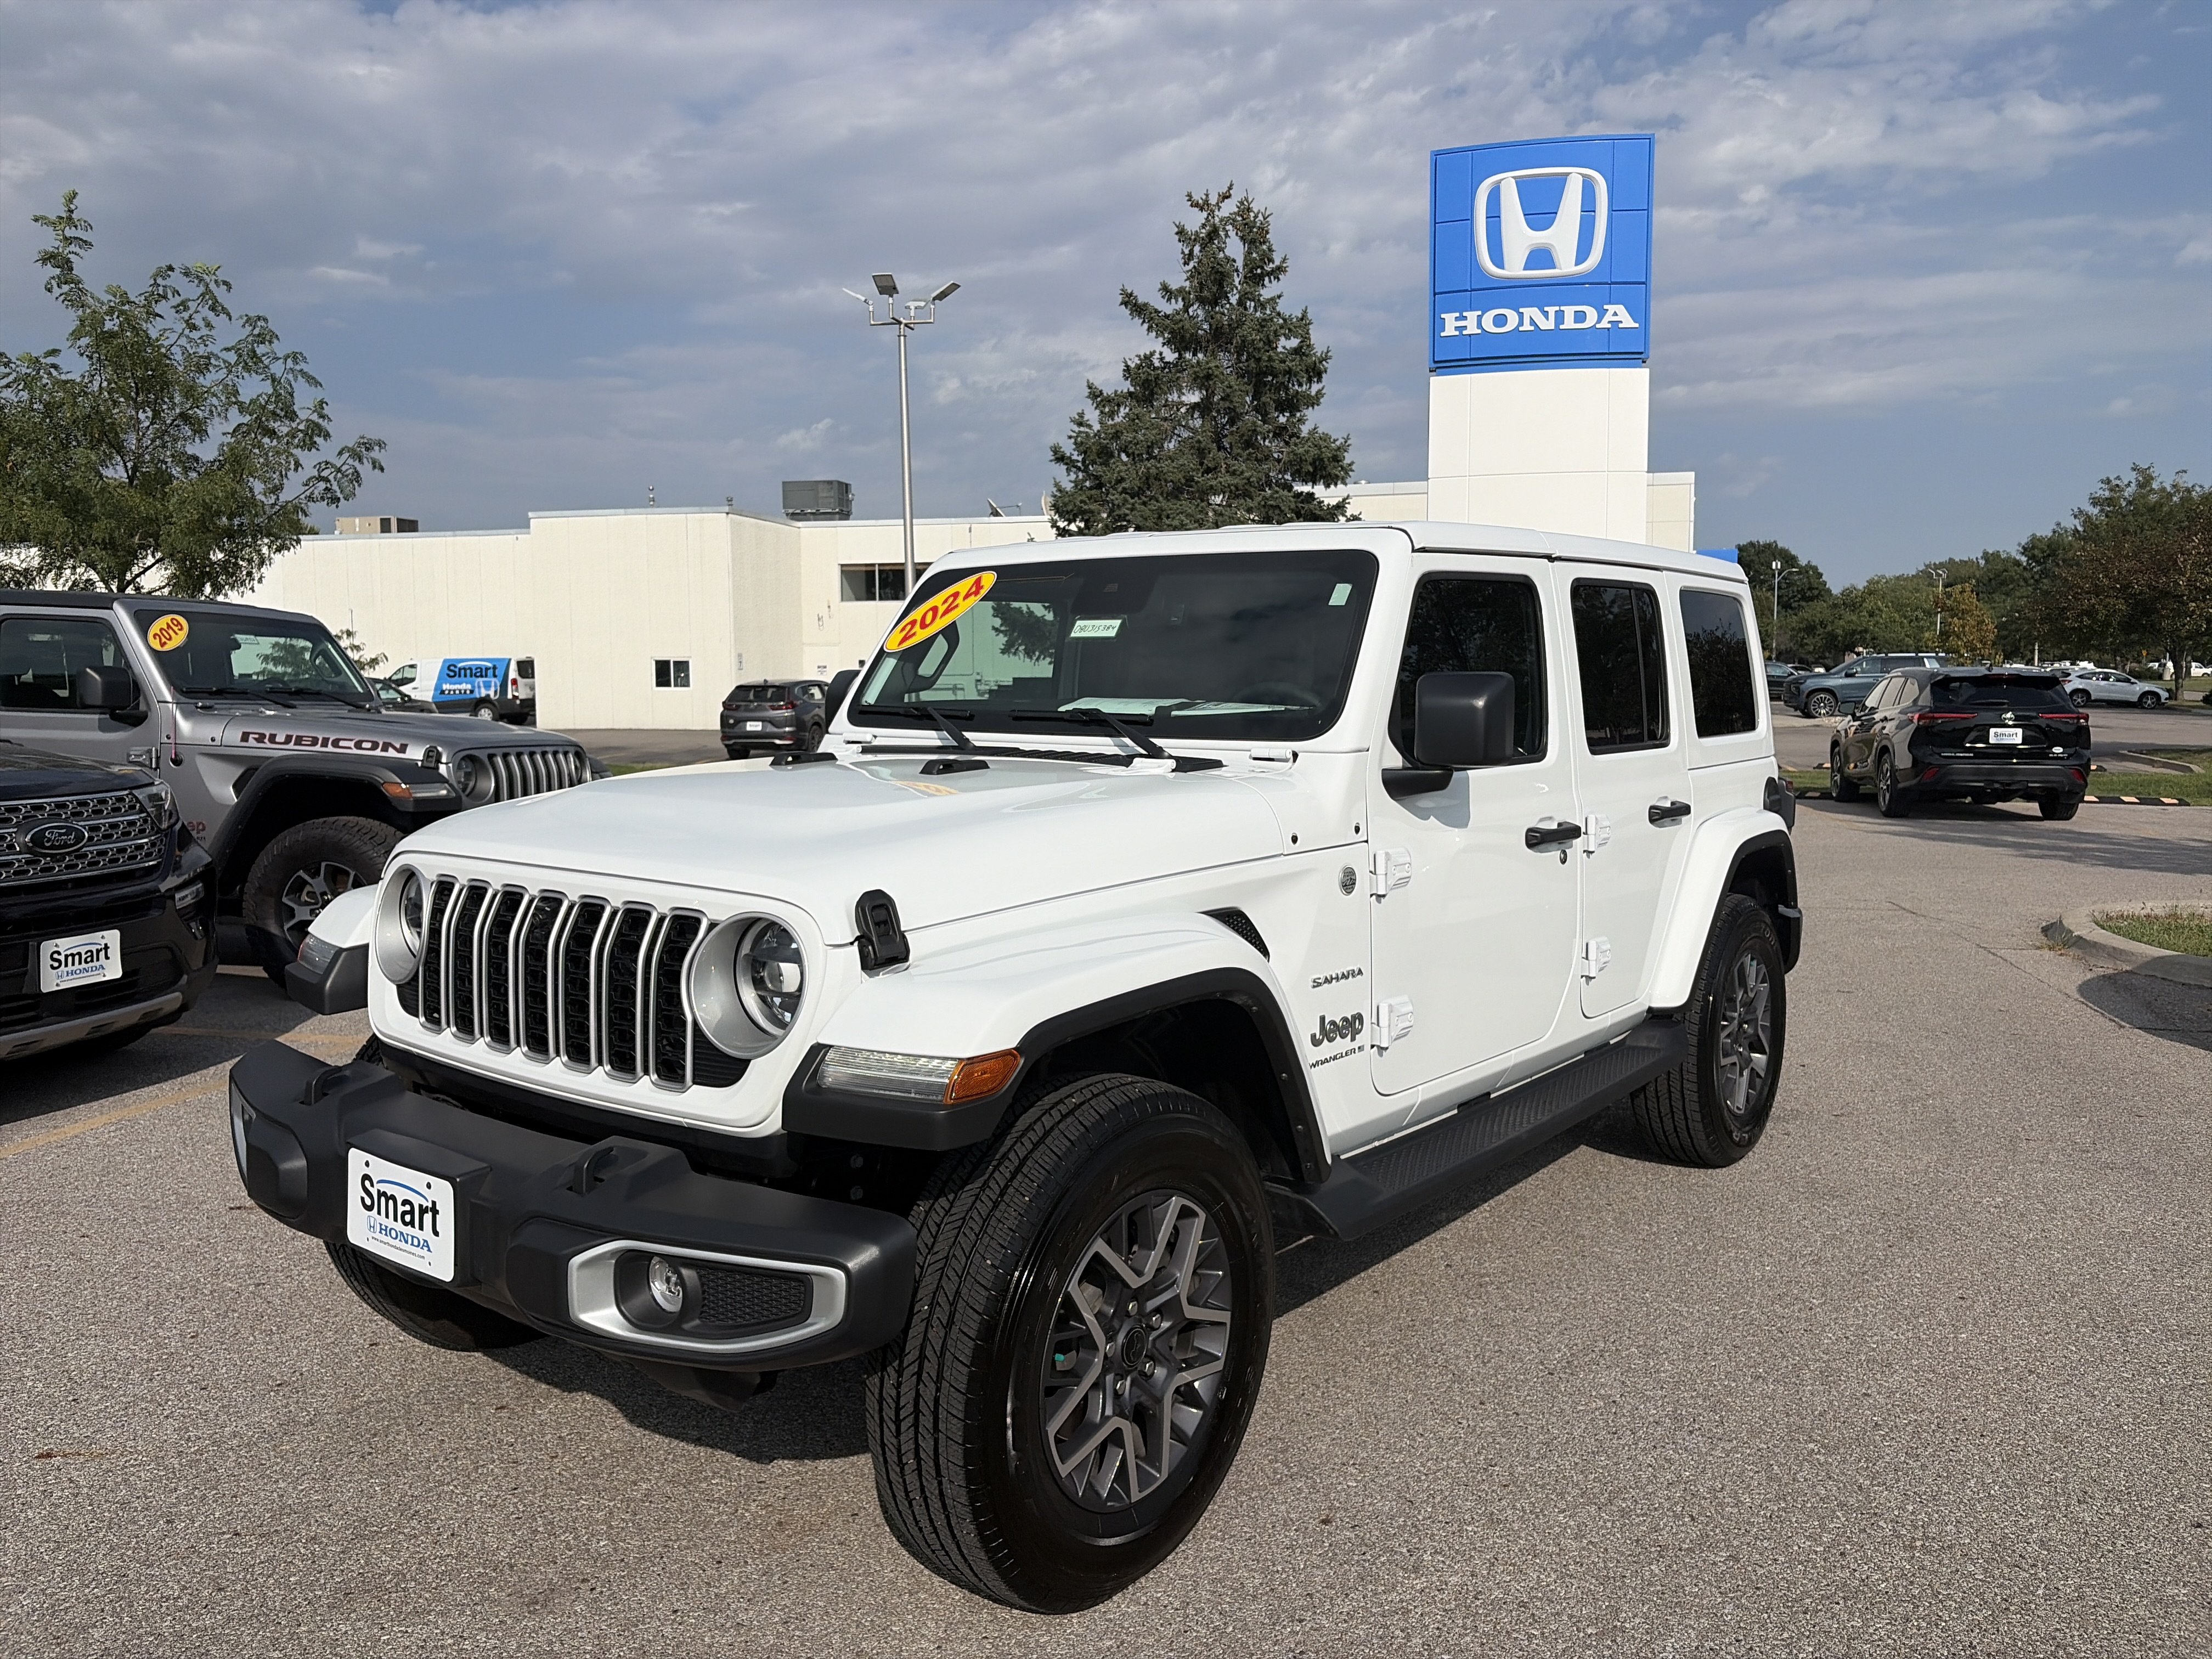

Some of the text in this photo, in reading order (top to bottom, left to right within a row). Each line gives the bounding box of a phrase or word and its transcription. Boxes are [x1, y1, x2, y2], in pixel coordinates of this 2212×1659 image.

[1440, 304, 1639, 337] HONDA
[898, 575, 985, 648] 2024
[153, 617, 184, 648] 2019
[446, 664, 498, 678] Smart
[240, 731, 409, 754] RUBICON
[44, 829, 76, 846] Ford
[49, 943, 110, 970] Smart
[65, 964, 105, 977] HONDA
[1311, 967, 1363, 989] SAHARA
[1310, 1012, 1364, 1047] Jeep
[1309, 1047, 1356, 1069] WRANGLER
[360, 1173, 440, 1238] Smart
[378, 1222, 433, 1254] HONDA
